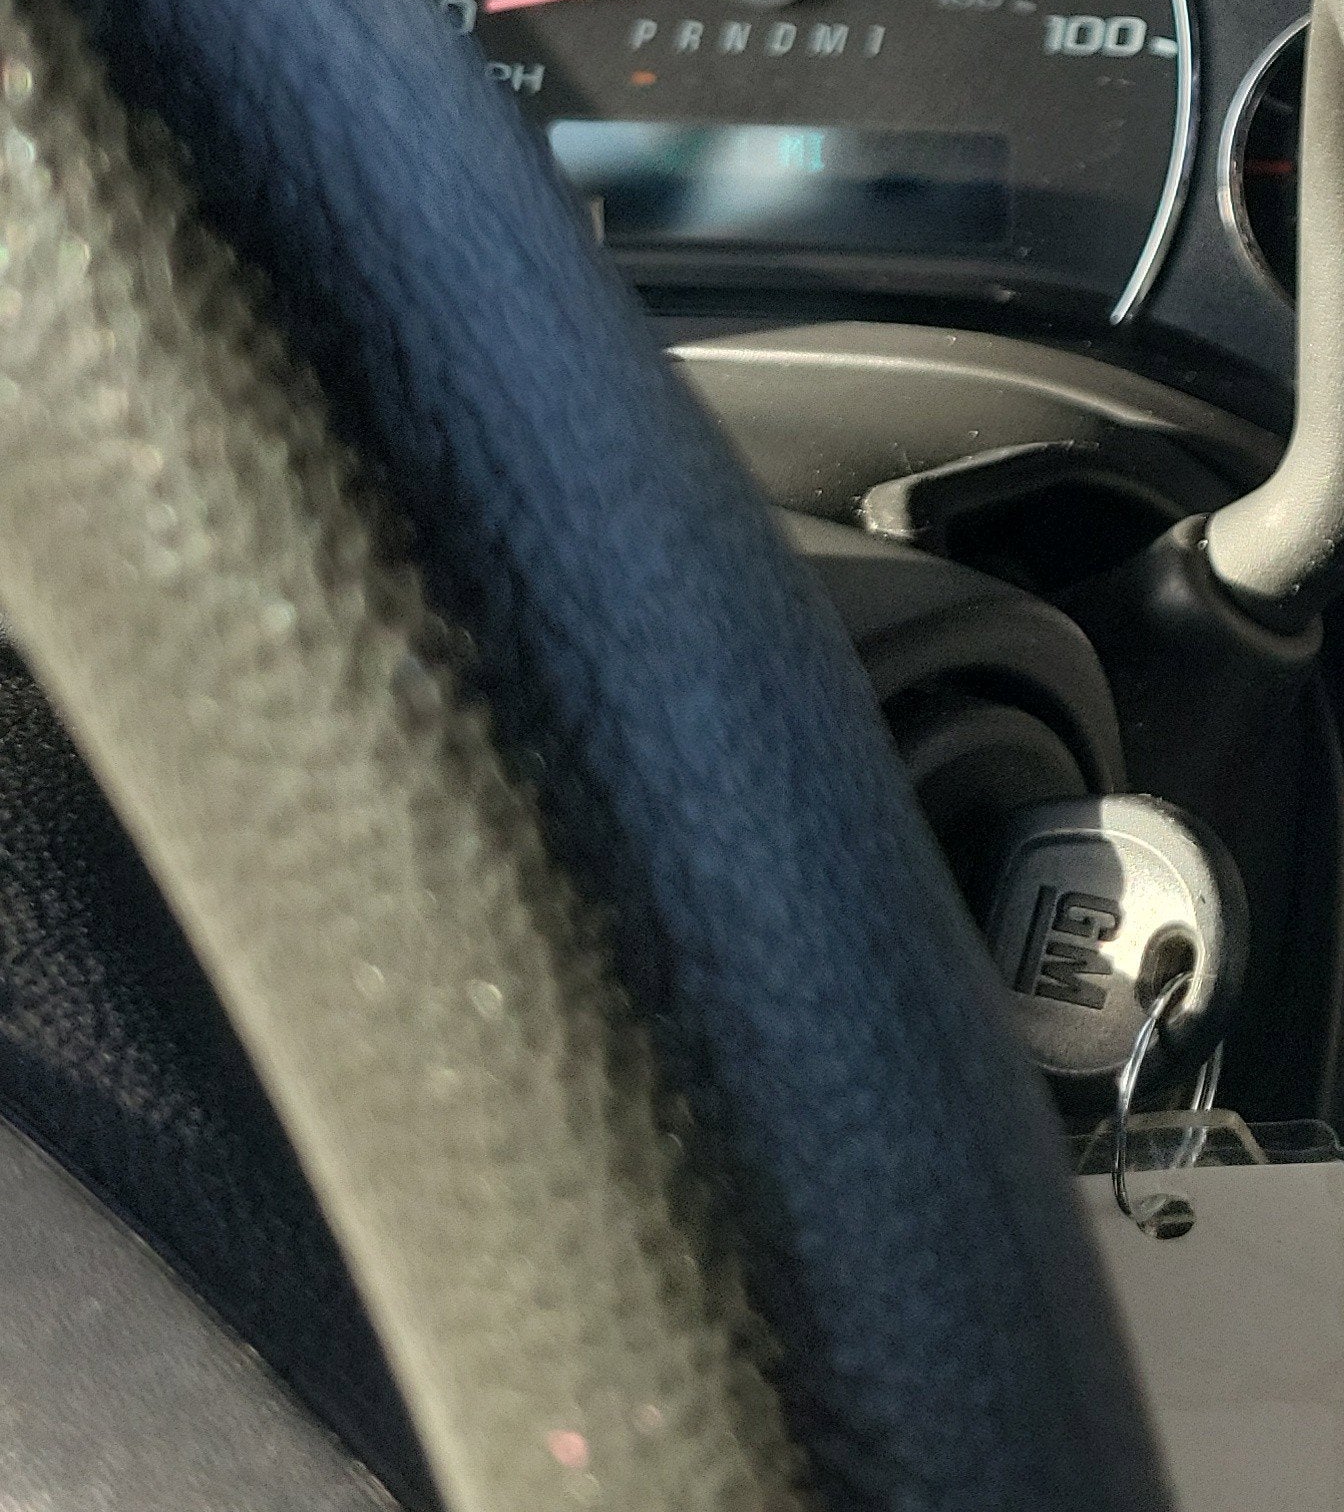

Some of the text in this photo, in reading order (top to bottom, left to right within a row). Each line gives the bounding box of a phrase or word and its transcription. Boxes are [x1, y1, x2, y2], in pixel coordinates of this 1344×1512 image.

[629, 18, 659, 52] P
[674, 19, 705, 53] R
[718, 21, 752, 54] N
[764, 21, 798, 56] D
[809, 23, 850, 57] M
[1044, 14, 1147, 57] 100
[1033, 890, 1121, 1009] GM
